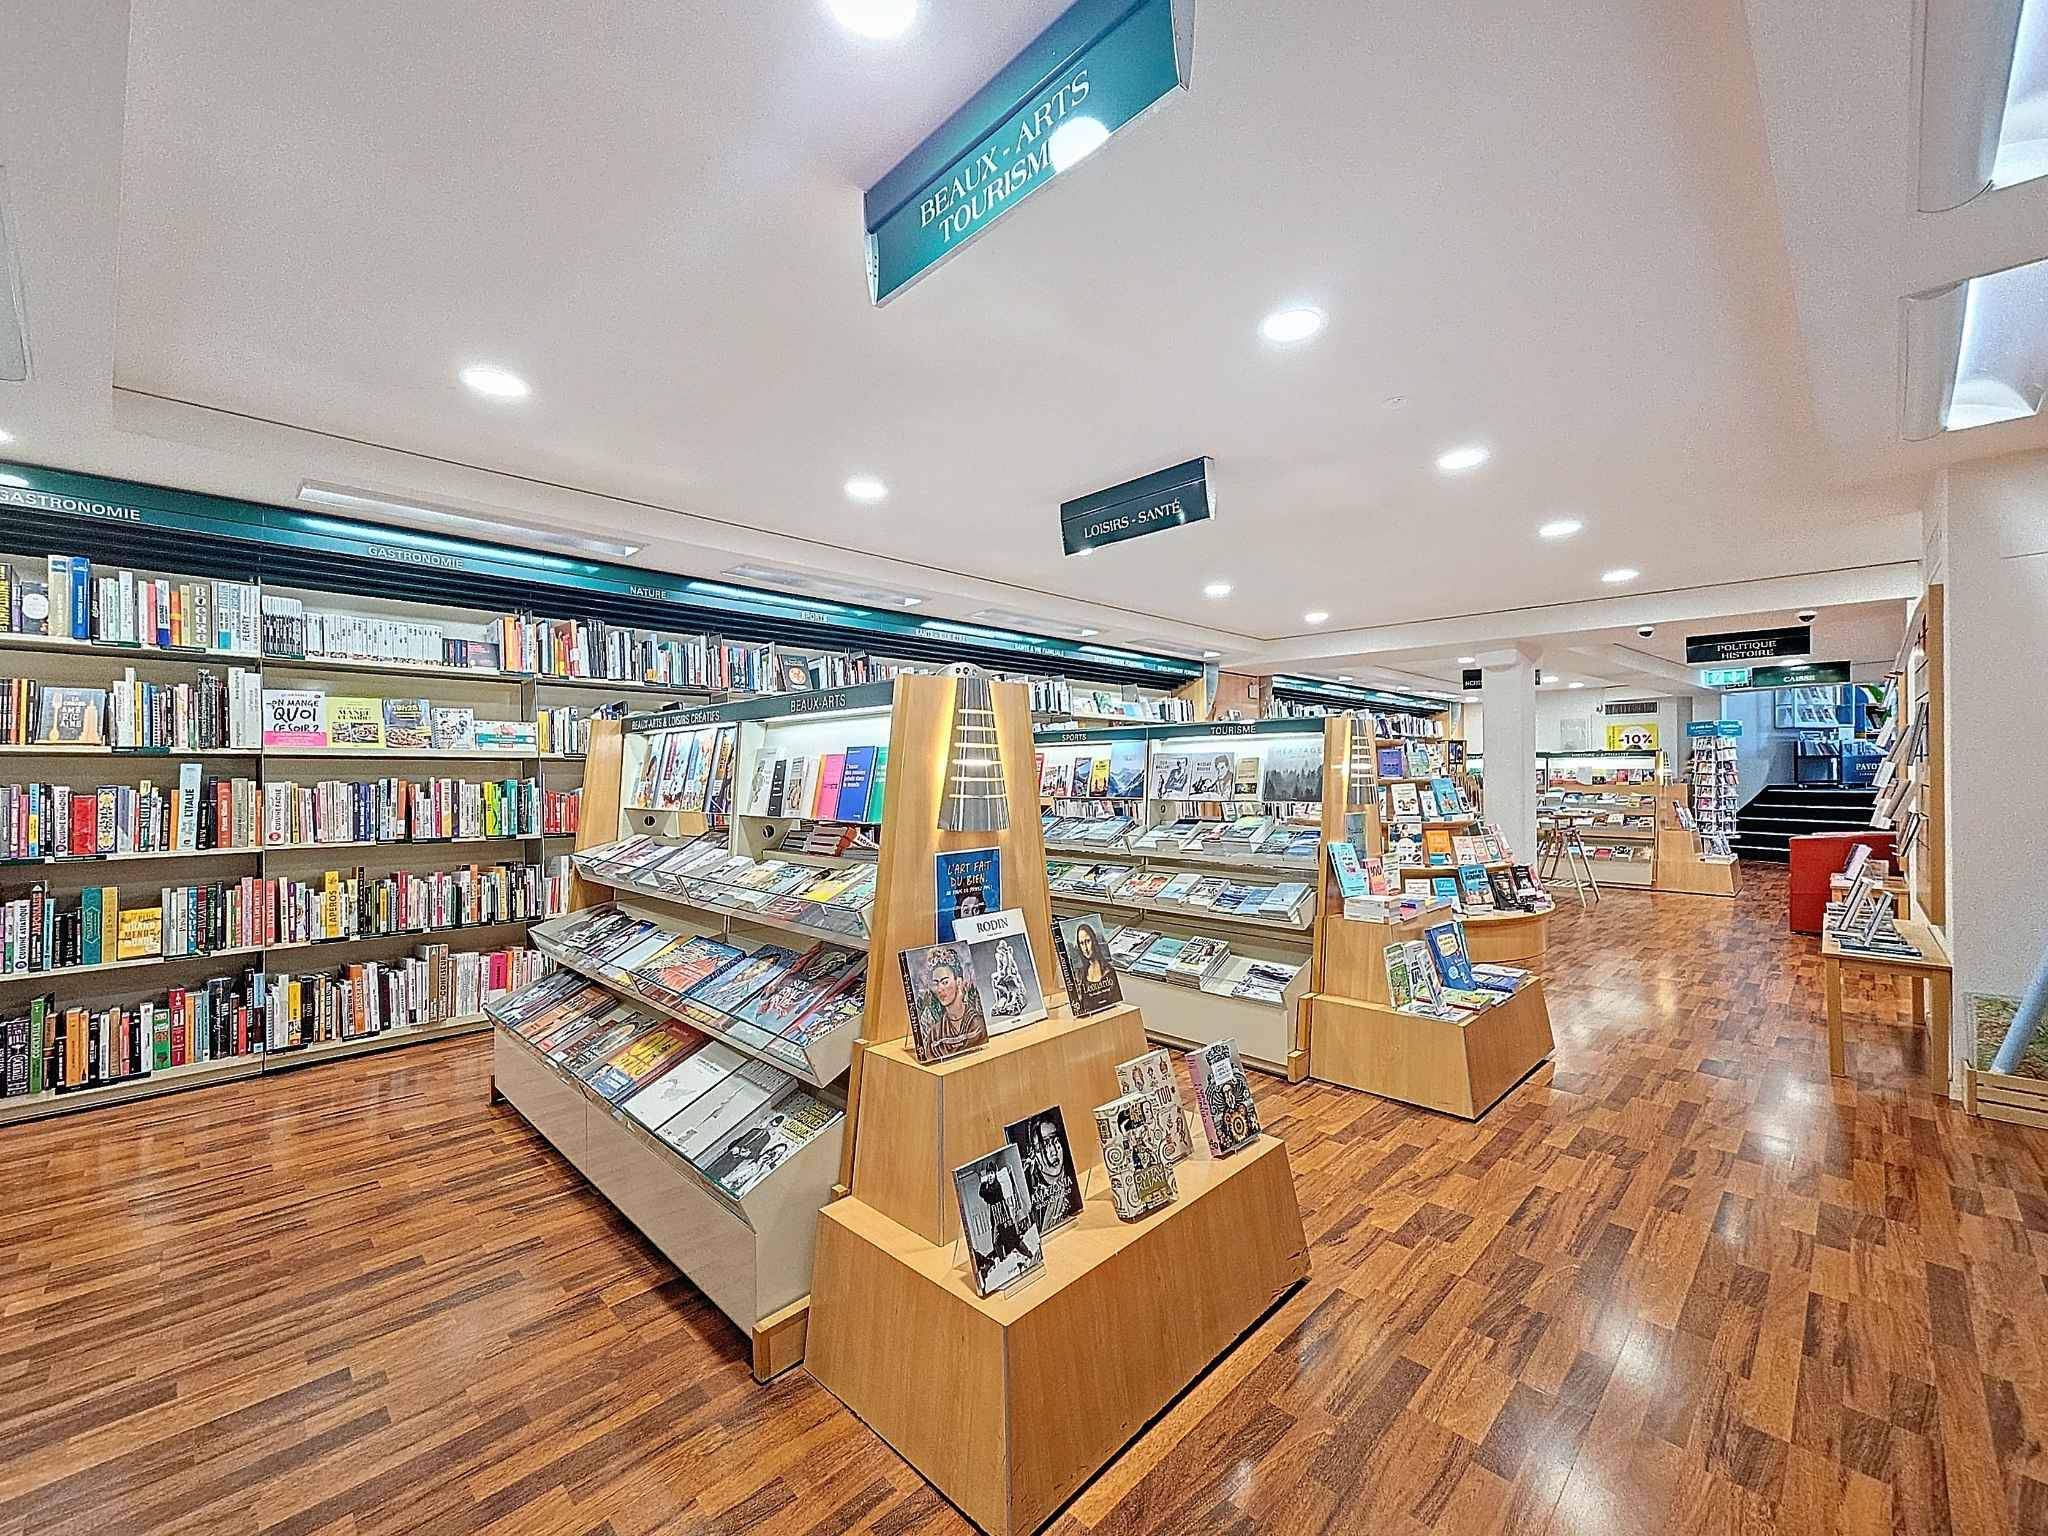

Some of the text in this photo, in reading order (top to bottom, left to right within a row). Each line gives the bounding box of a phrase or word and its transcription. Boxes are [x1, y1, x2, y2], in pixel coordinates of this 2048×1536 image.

[919, 145, 1000, 229] BEAUX
[1016, 69, 1091, 155] ARTS
[938, 140, 1052, 243] TOURISM
[1084, 516, 1130, 539] LOISIRS
[1138, 497, 1182, 524] SANTÉ
[368, 546, 464, 569] GASTRONOMIE
[630, 585, 667, 600] NATURE
[1717, 640, 1777, 652] POLITIQUE
[1721, 649, 1775, 659] HISTOIRE
[287, 700, 319, 708] MANGE
[790, 695, 847, 713] BEAUX-ARTS
[273, 707, 316, 723] QUOI
[668, 716, 690, 726] LOISIRS
[691, 711, 720, 724] CRÉATIFS
[1210, 724, 1256, 736] TOURISME
[1062, 733, 1087, 743] SPORTS
[1618, 734, 1653, 745] -10%
[947, 860, 992, 875] L'ART FAIT
[950, 877, 962, 887] DU
[976, 917, 1009, 933] RODIN
[1059, 951, 1074, 992] Leonardo
[908, 1002, 919, 1033] Kahlo
